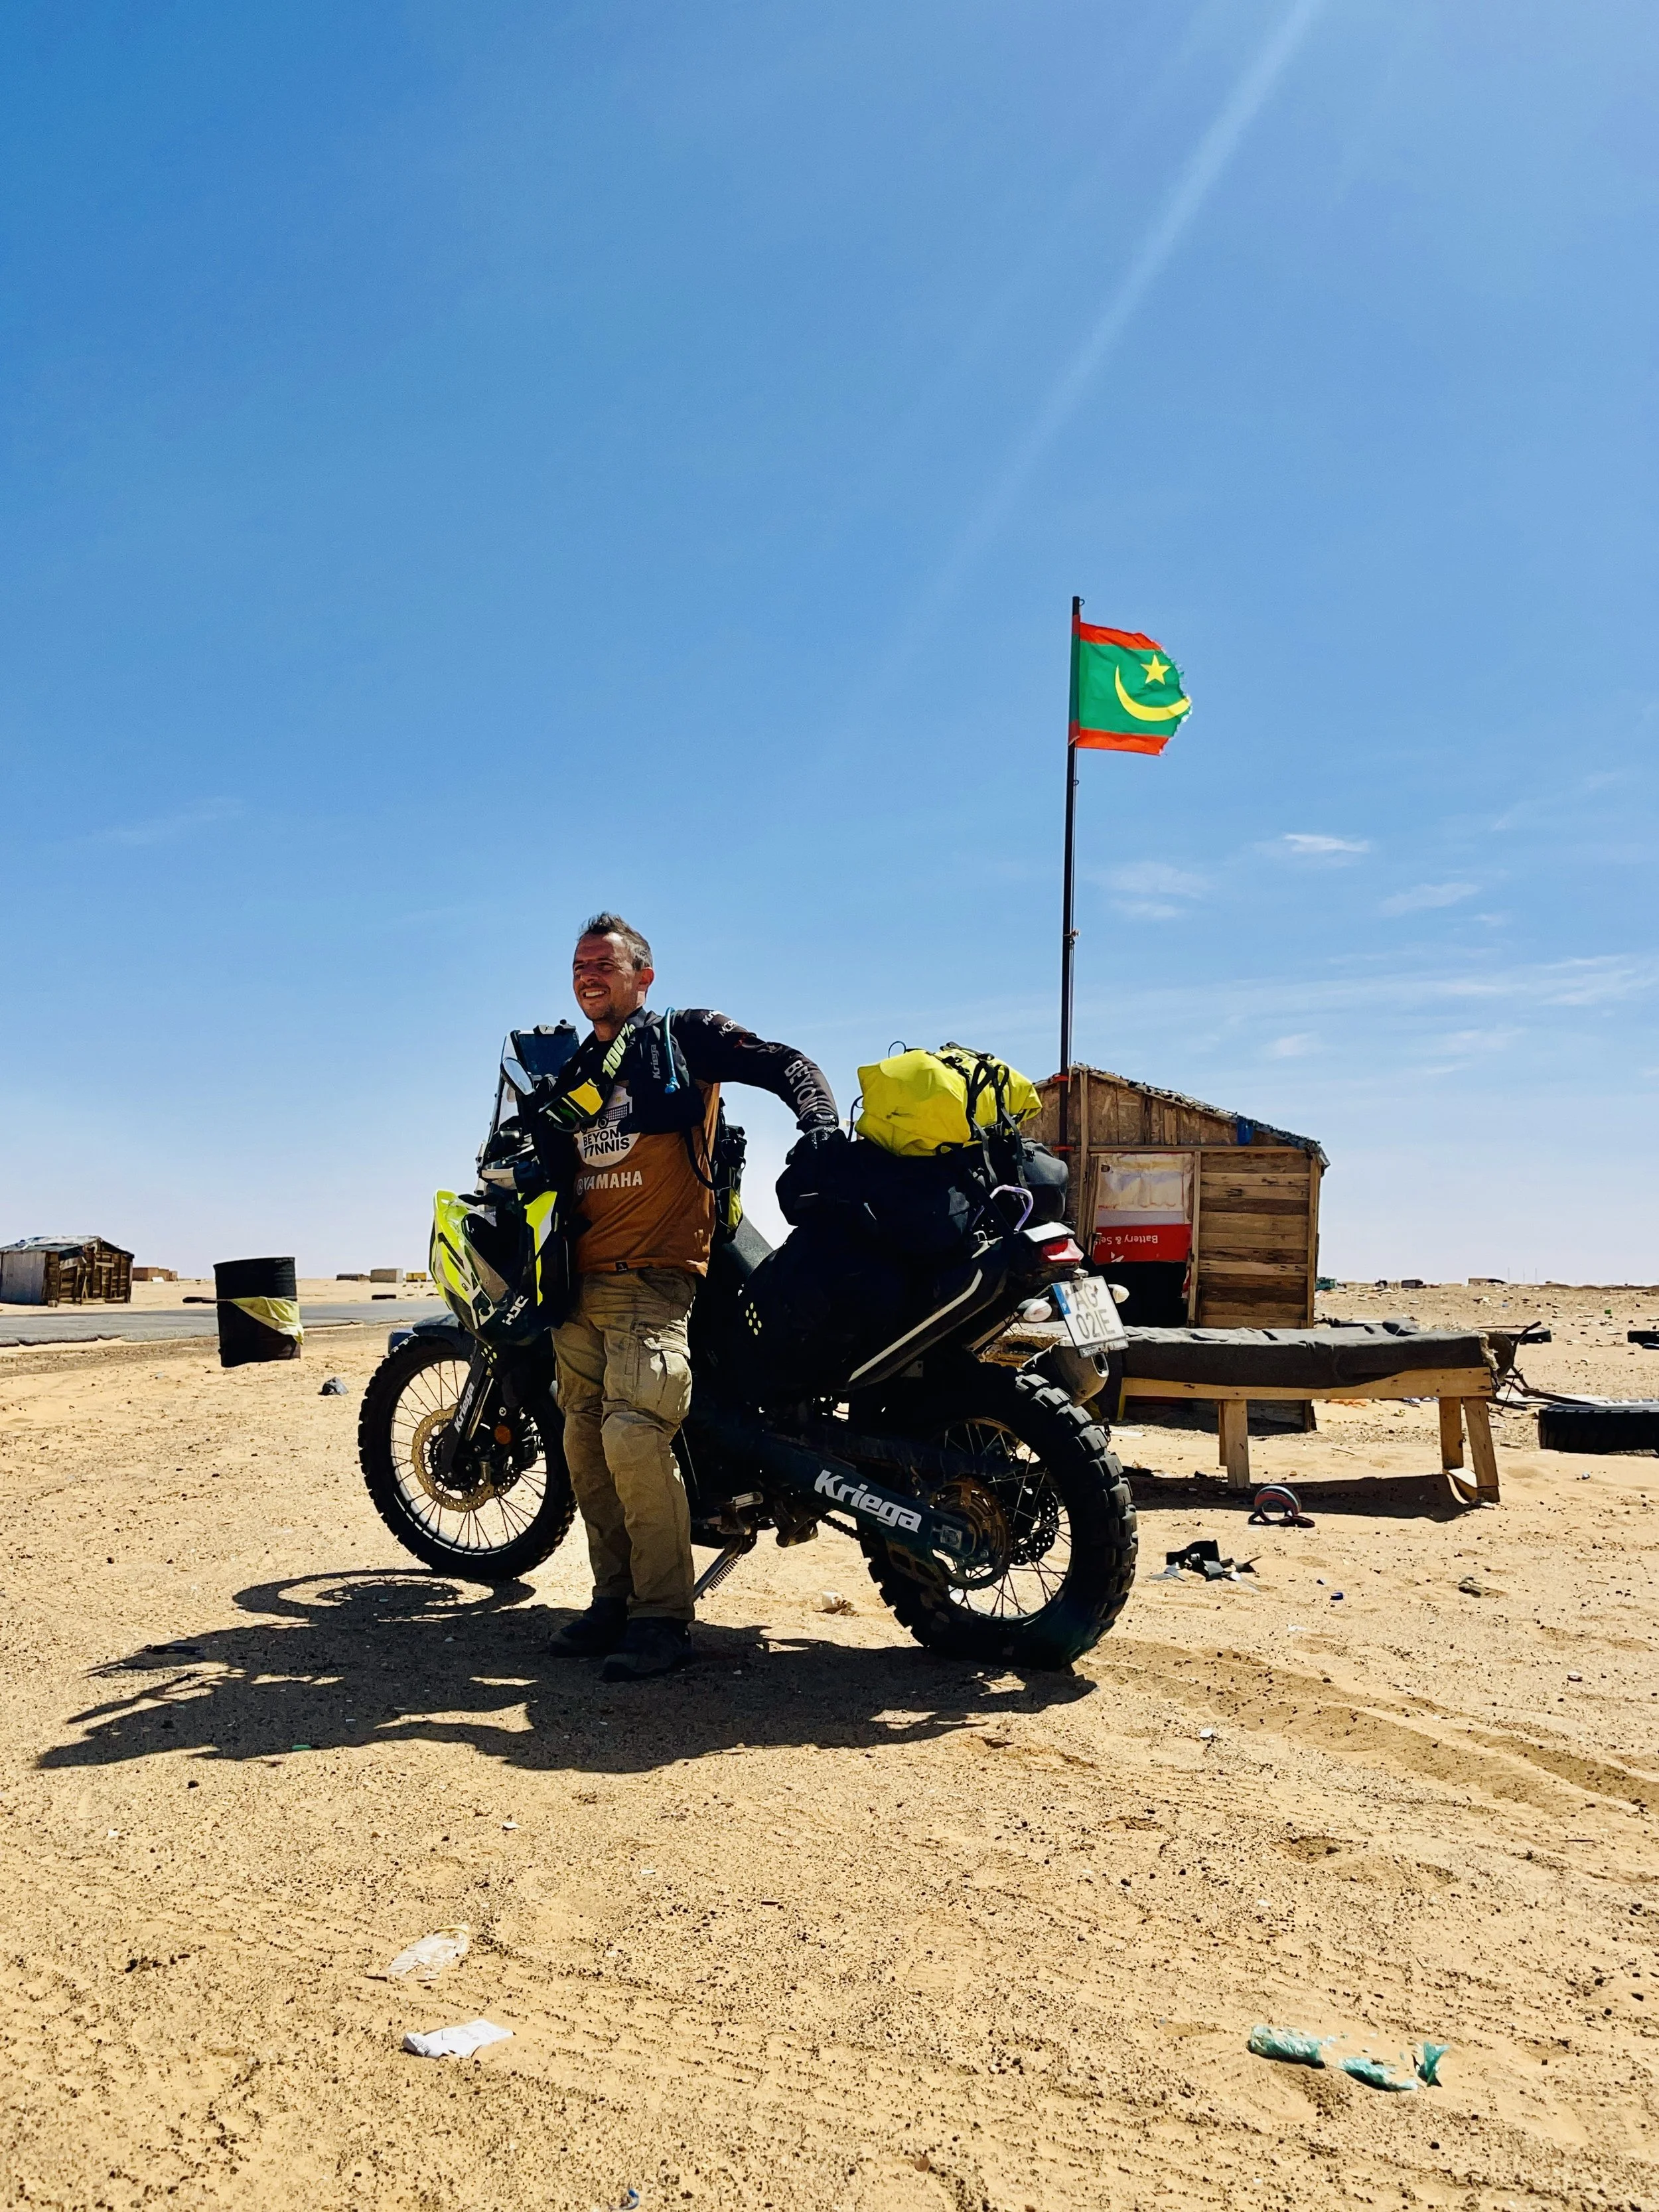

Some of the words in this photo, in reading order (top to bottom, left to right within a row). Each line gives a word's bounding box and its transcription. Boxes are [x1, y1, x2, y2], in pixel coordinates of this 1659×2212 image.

[602, 1022, 636, 1079] 100%
[650, 1044, 661, 1080] Kriega
[584, 1170, 643, 1190] YAMAHA
[1115, 1236, 1122, 1245] &
[1124, 1234, 1159, 1244] Battery
[501, 1295, 530, 1326] HJC
[453, 1382, 474, 1434] Kriega
[814, 1469, 922, 1534] Kriega
